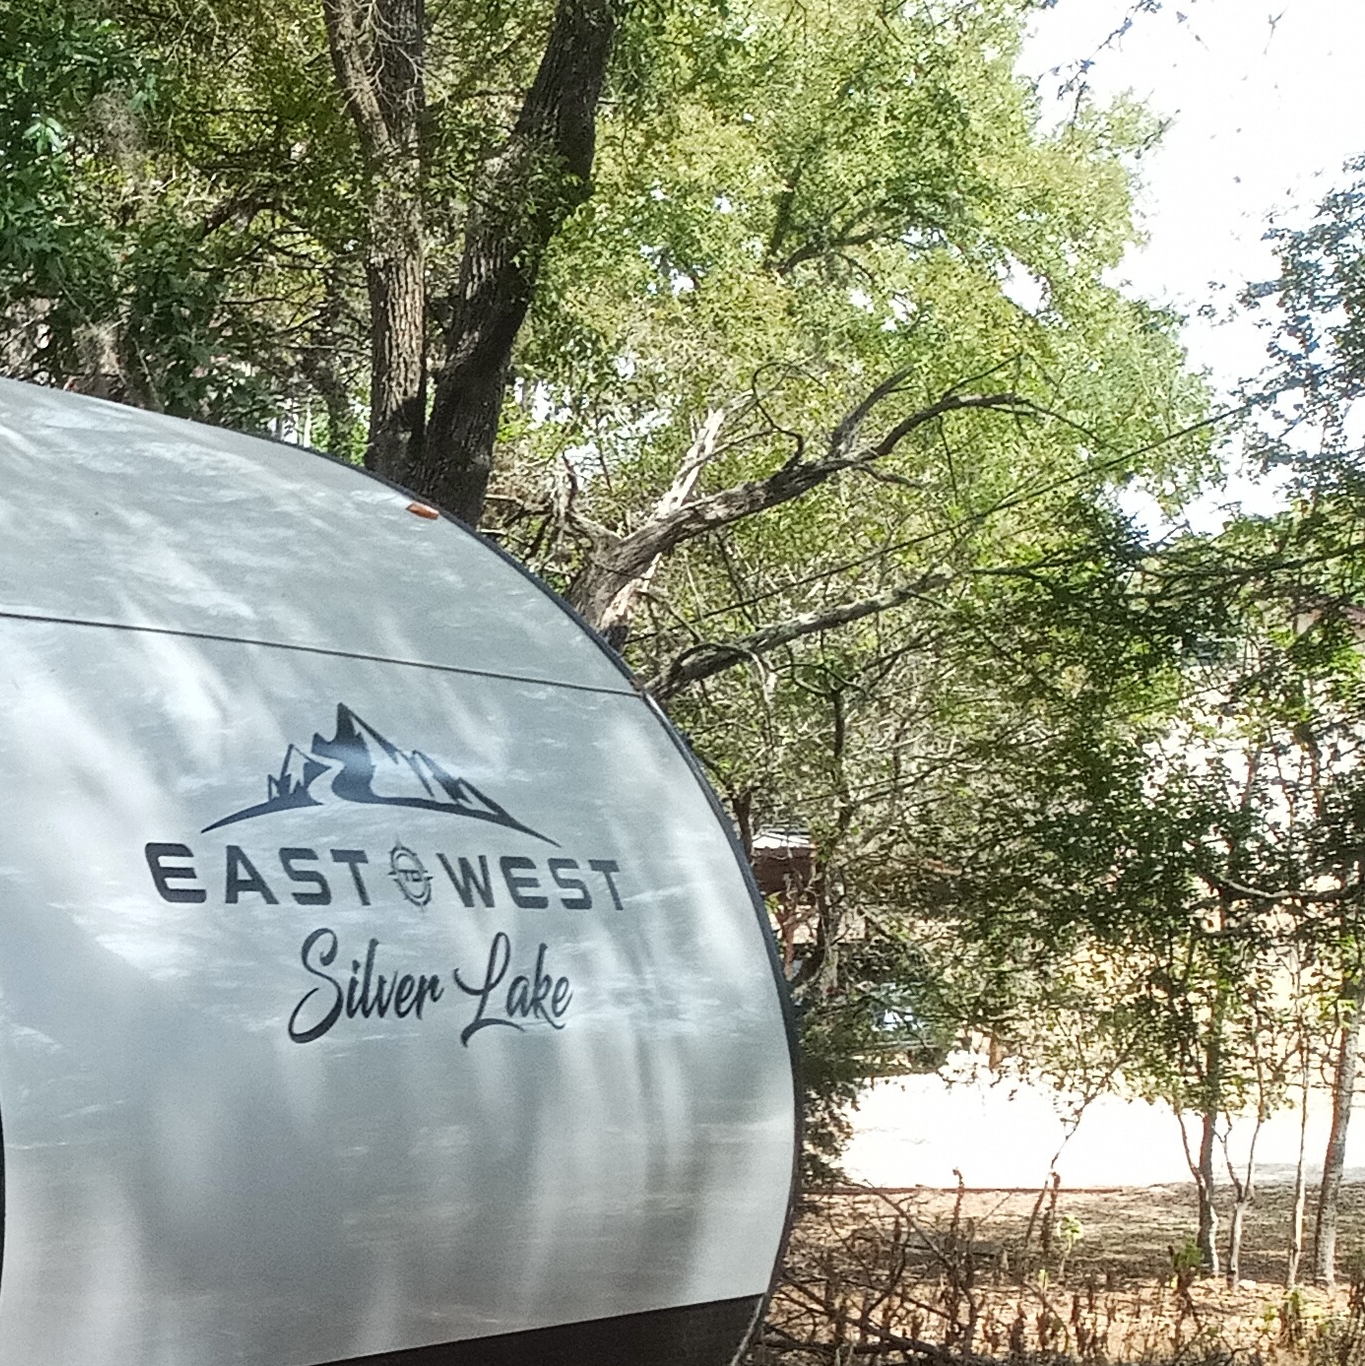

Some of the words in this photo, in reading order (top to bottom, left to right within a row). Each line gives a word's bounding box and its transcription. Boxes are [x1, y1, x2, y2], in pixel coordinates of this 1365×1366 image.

[143, 841, 371, 907] EAST
[435, 851, 625, 912] WEST
[287, 927, 445, 1044] Silver
[452, 931, 574, 1048] Lake
